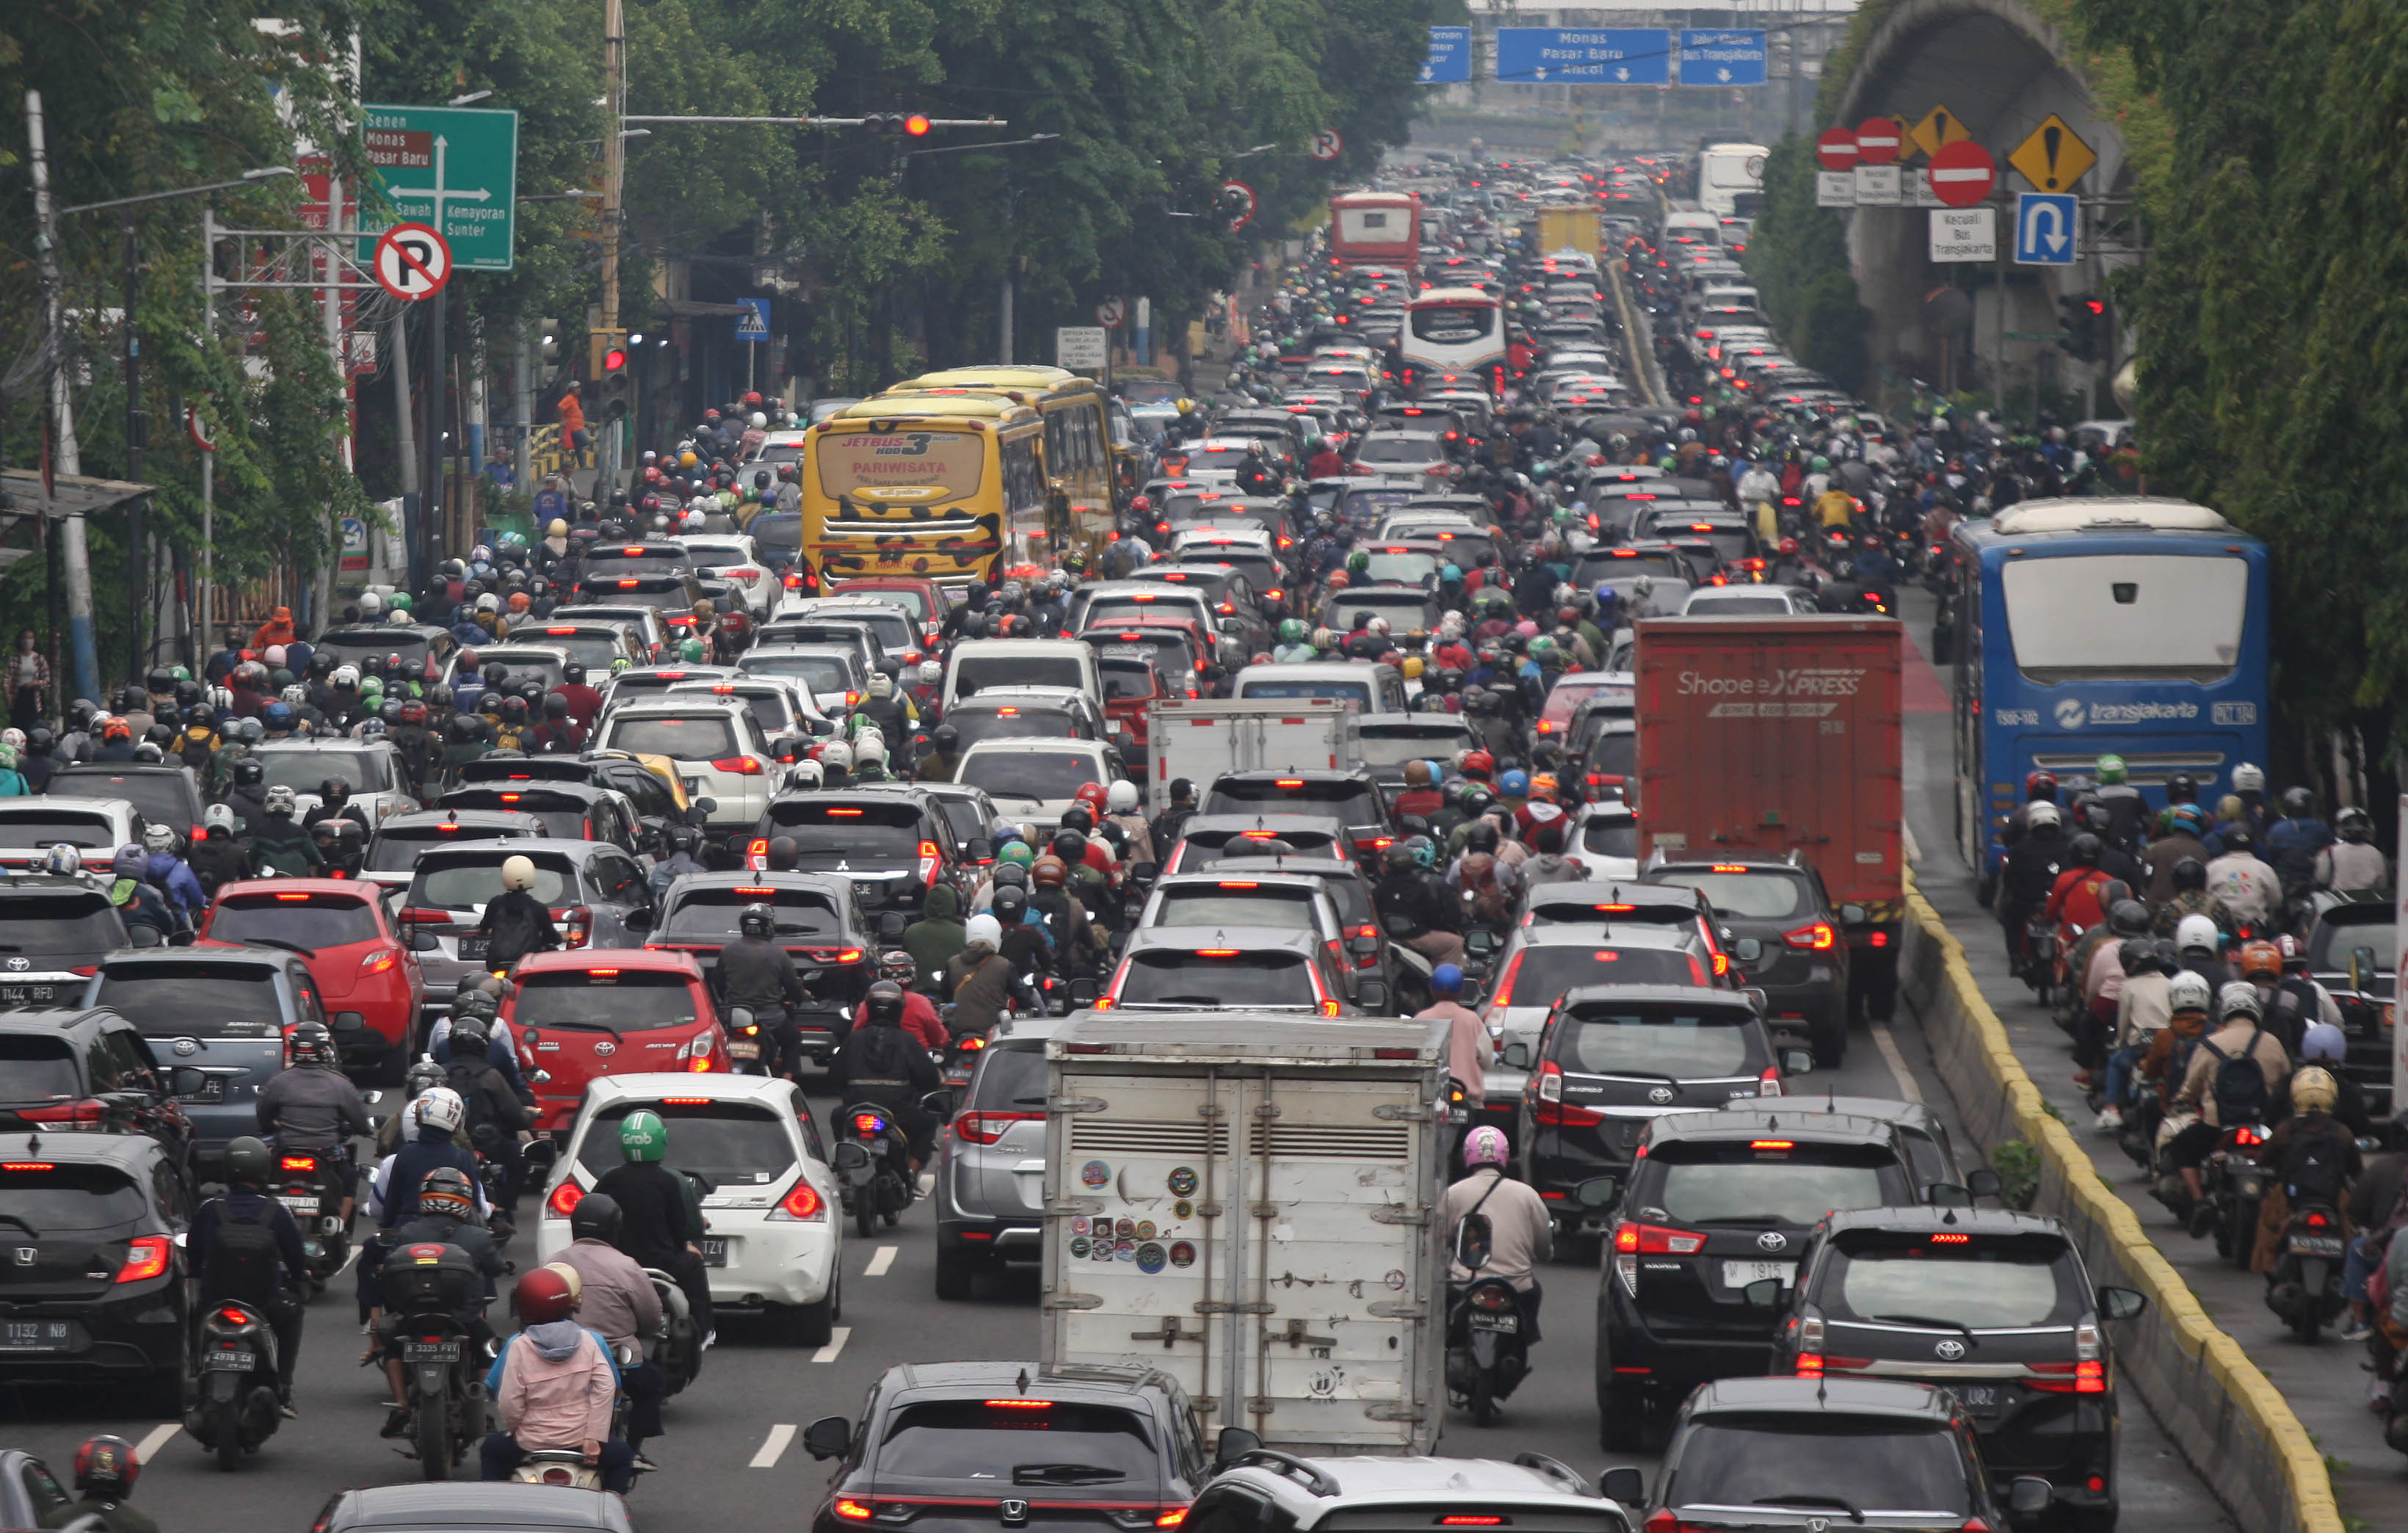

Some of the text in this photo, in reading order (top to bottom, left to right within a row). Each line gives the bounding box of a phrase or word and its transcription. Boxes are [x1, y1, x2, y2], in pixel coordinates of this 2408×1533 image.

[1559, 32, 1607, 44] Monas
[1542, 48, 1623, 59] Pasar Baru
[1683, 49, 1702, 60] Bus
[1562, 63, 1603, 75] Ancol
[369, 113, 406, 128] Senen
[366, 131, 406, 146] Monas
[367, 151, 429, 165] Pasar Baru
[396, 202, 431, 217] Sawah
[447, 205, 505, 221] Kemayoran
[1945, 213, 1981, 225] Kecuali
[447, 222, 485, 236] Sunter
[1954, 229, 1971, 240] Bus
[1934, 243, 1993, 257] Transjakarta
[841, 438, 904, 447] JETBUS
[852, 462, 947, 474] PARIWISATA
[2090, 700, 2199, 723] transjakarta
[461, 940, 468, 951] B
[34, 987, 53, 999] RFD
[622, 1132, 653, 1145] Grab
[703, 1240, 725, 1255] TZY
[1750, 1264, 1782, 1279] 1915
[7, 1324, 38, 1338] 1132
